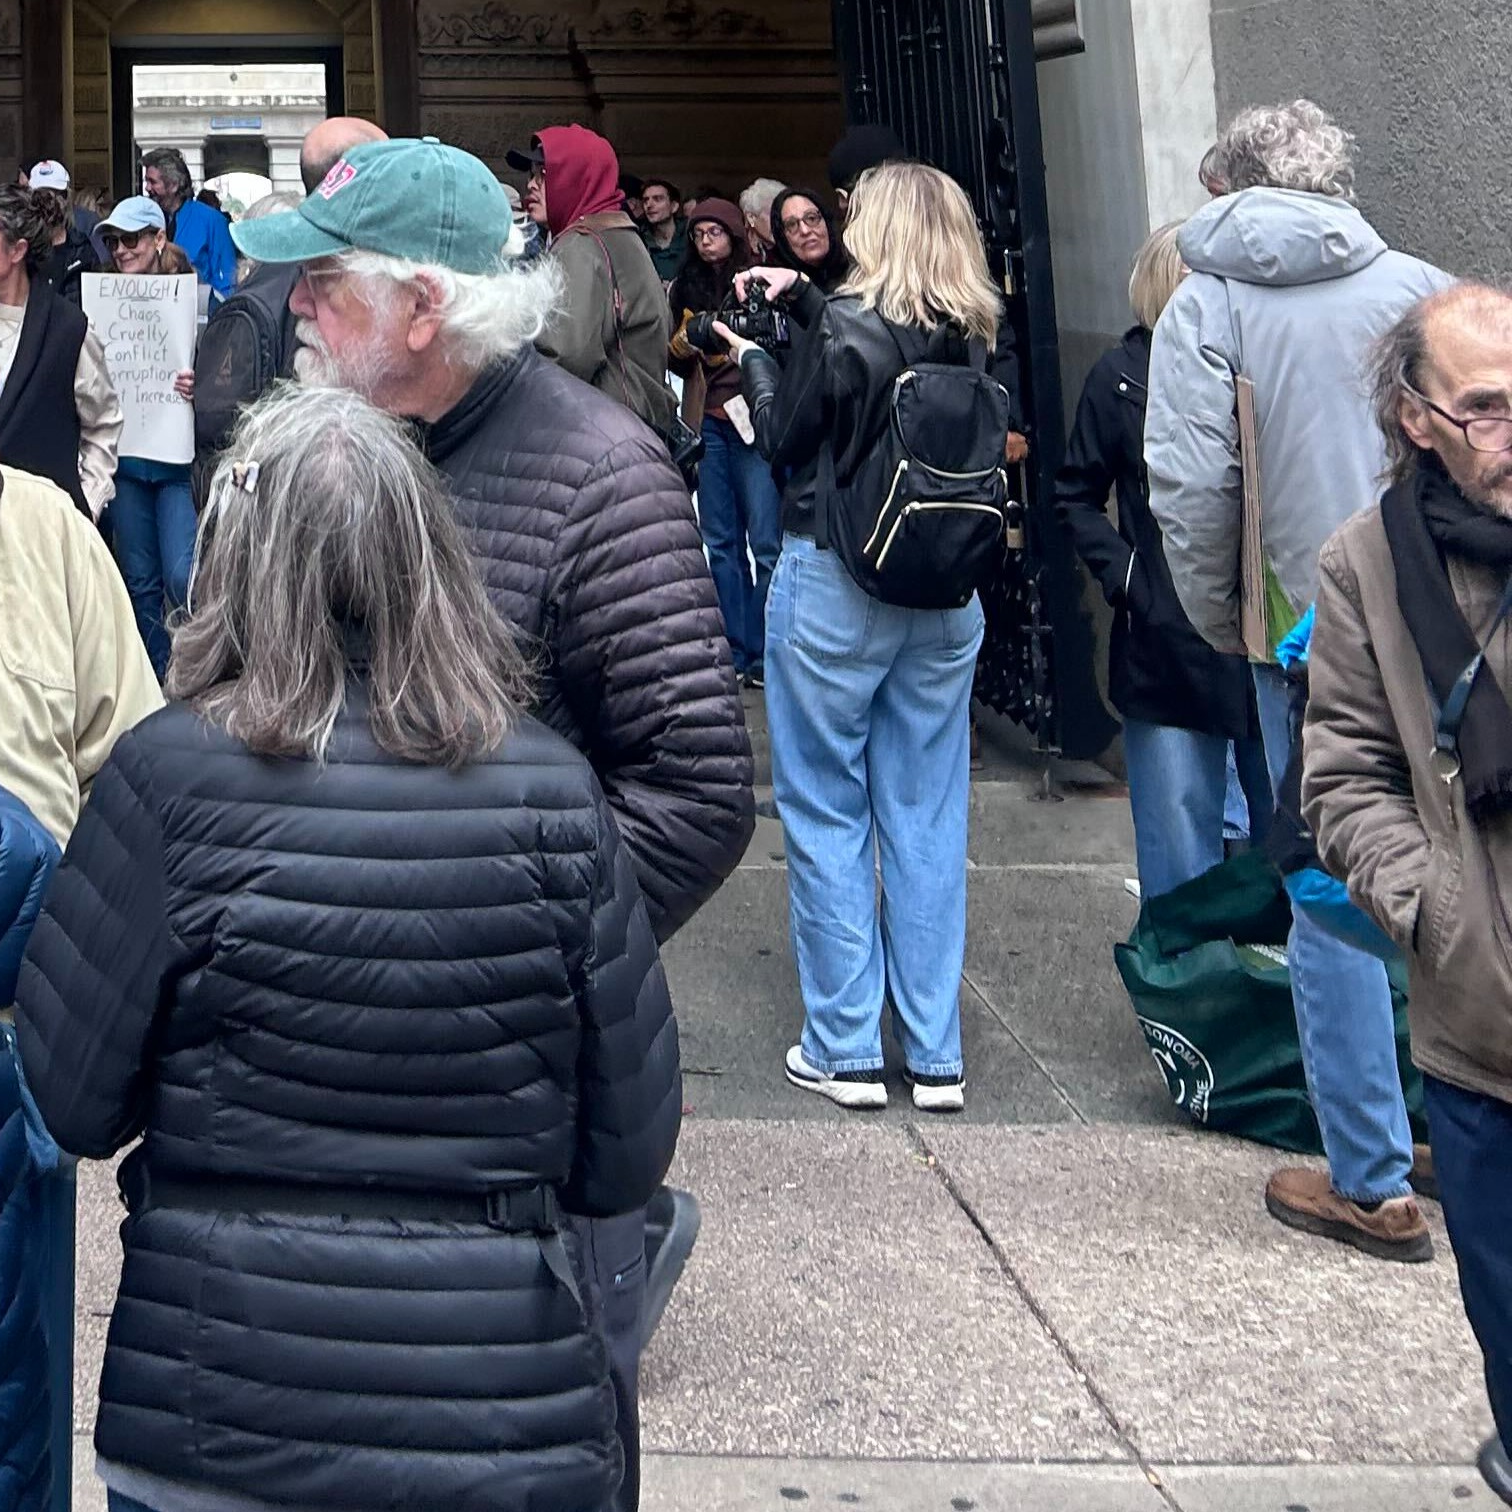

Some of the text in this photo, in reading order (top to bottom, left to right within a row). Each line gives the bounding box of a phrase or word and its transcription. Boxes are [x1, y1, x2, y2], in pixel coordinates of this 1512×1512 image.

[118, 304, 161, 323] Chaos
[108, 323, 168, 345] Cruelty
[110, 366, 178, 385] orruption
